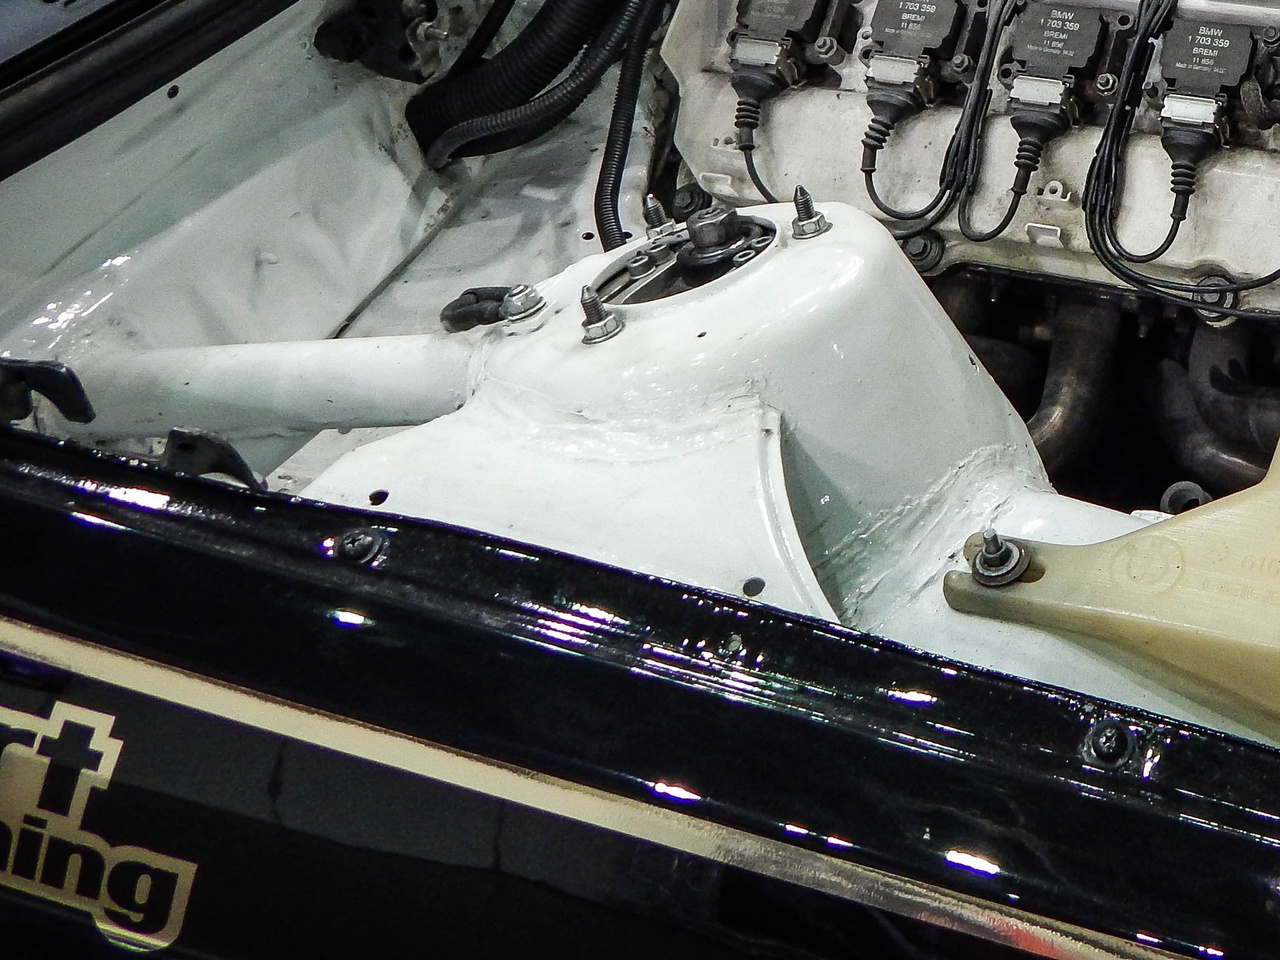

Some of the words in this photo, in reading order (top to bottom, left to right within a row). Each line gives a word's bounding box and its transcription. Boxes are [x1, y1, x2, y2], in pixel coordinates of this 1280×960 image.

[905, 2, 919, 11] 703
[921, 4, 936, 13] 359
[902, 13, 925, 21] BREMI
[1050, 9, 1074, 20] BMW
[1046, 19, 1062, 28] 703
[1063, 21, 1080, 31] 359
[1043, 30, 1068, 39] BREMI
[1199, 26, 1223, 37] BMW
[1195, 36, 1211, 45] 703
[1212, 38, 1230, 48] 359
[1192, 47, 1218, 57] BREMI
[1201, 58, 1214, 66] 856
